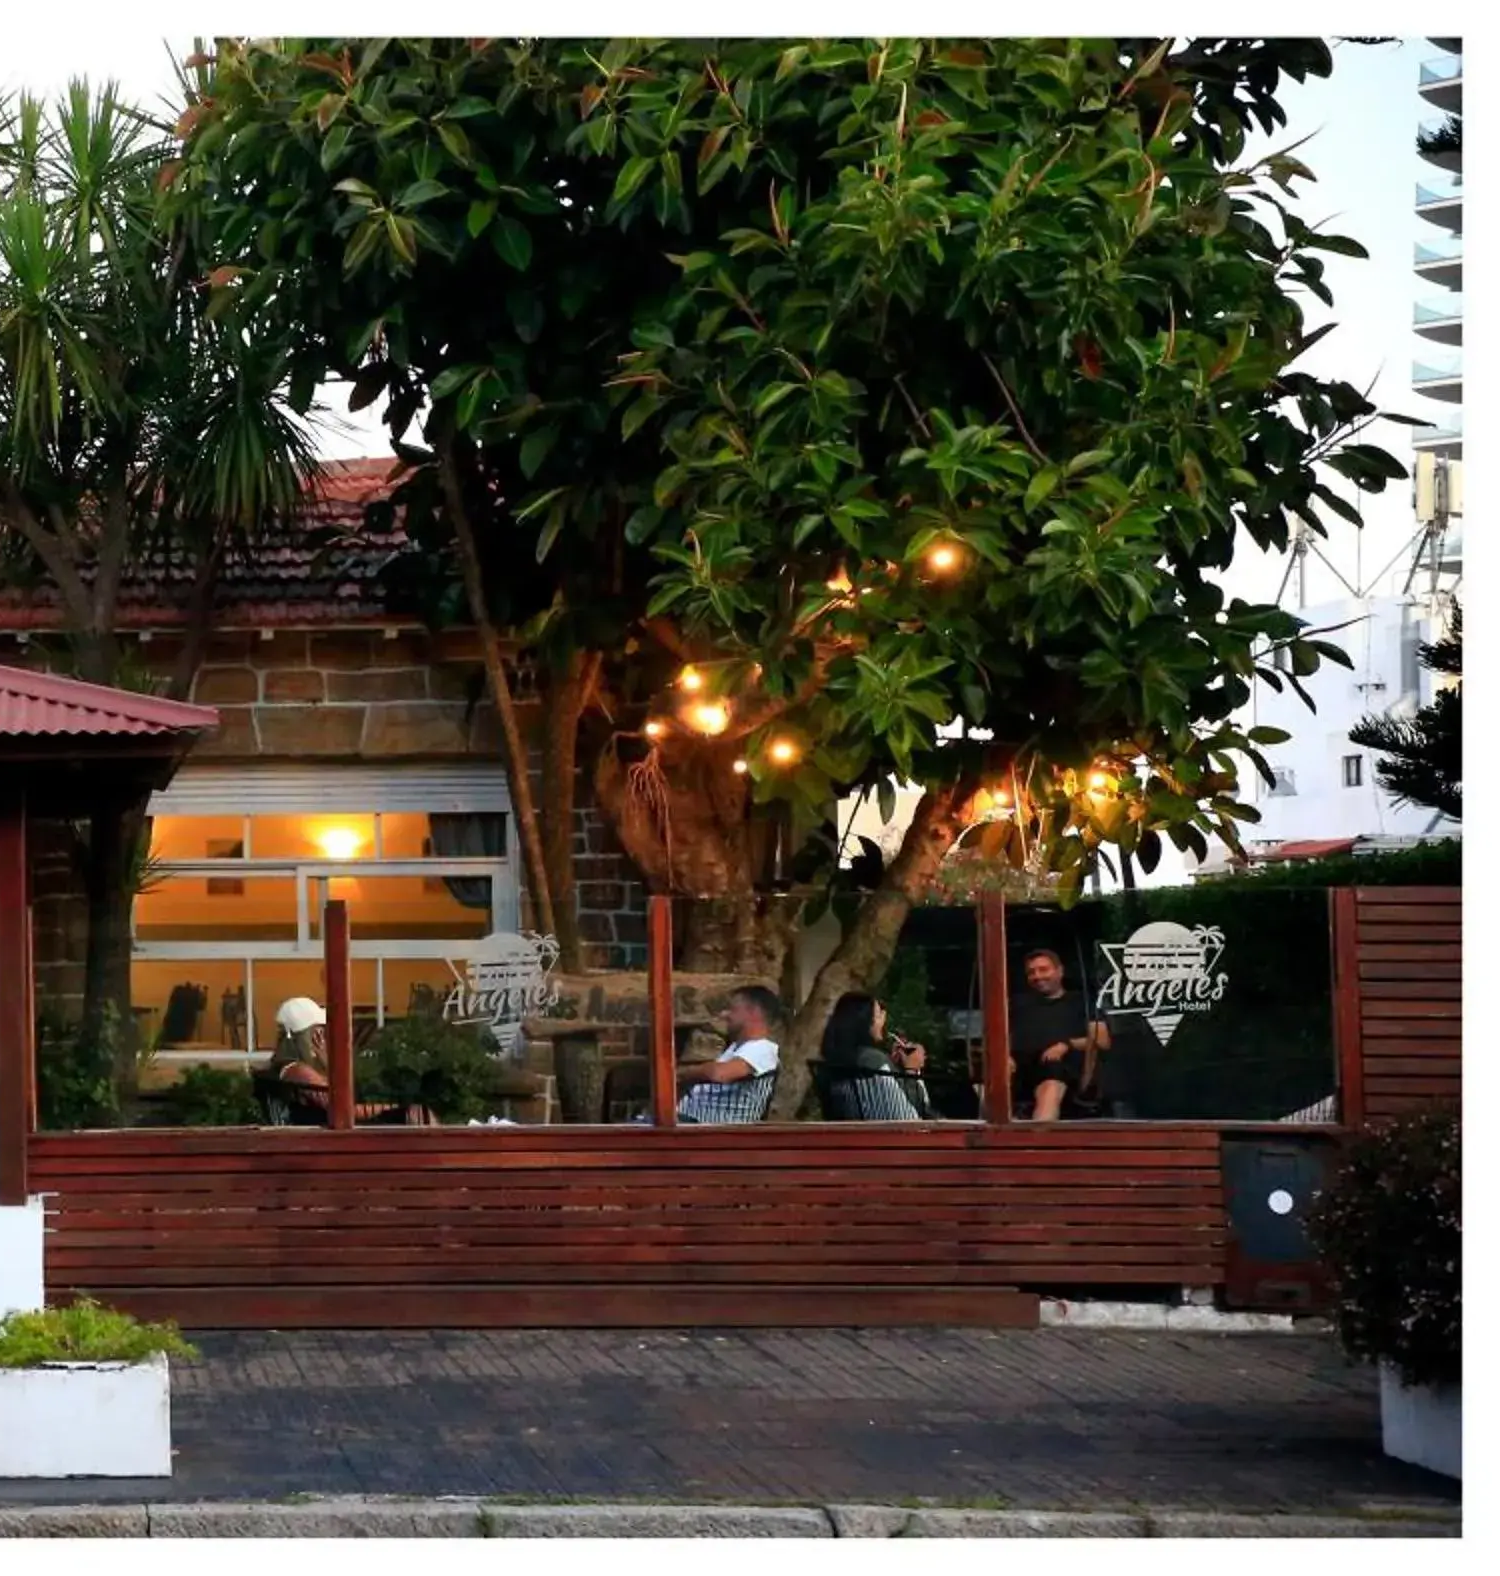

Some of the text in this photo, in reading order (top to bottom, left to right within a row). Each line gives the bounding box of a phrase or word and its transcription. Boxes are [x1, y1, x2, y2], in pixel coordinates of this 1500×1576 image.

[442, 978, 563, 1025] Angeles
[1096, 971, 1229, 1017] Angeles
[1179, 1001, 1211, 1012] Hotel
